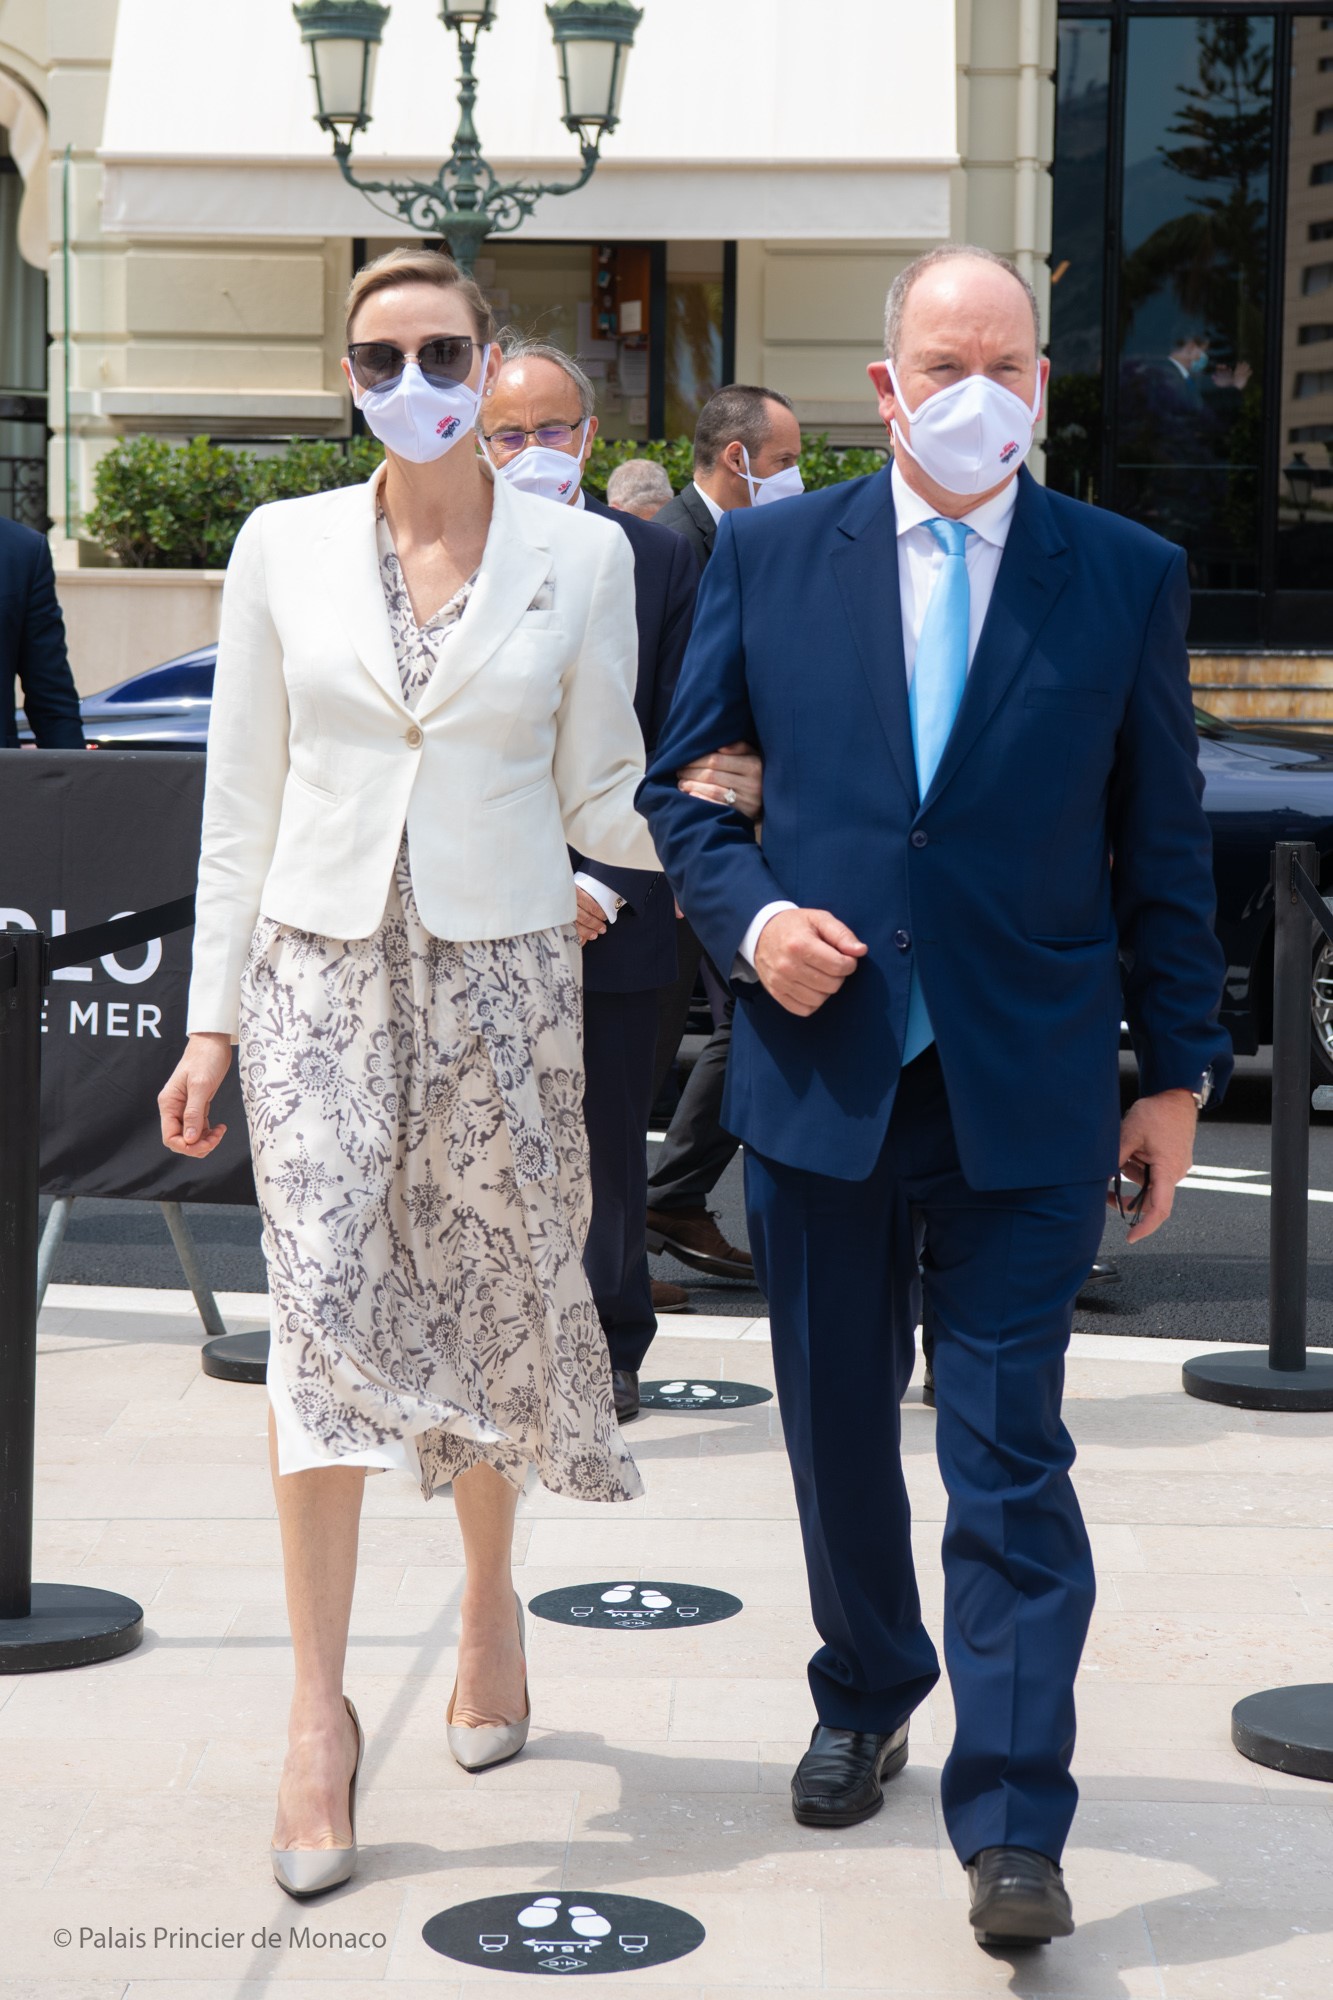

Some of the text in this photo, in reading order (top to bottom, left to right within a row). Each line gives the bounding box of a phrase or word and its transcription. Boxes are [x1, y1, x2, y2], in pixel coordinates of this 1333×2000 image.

[69, 1000, 162, 1038] MER
[534, 1944, 592, 1953] 1,5 M
